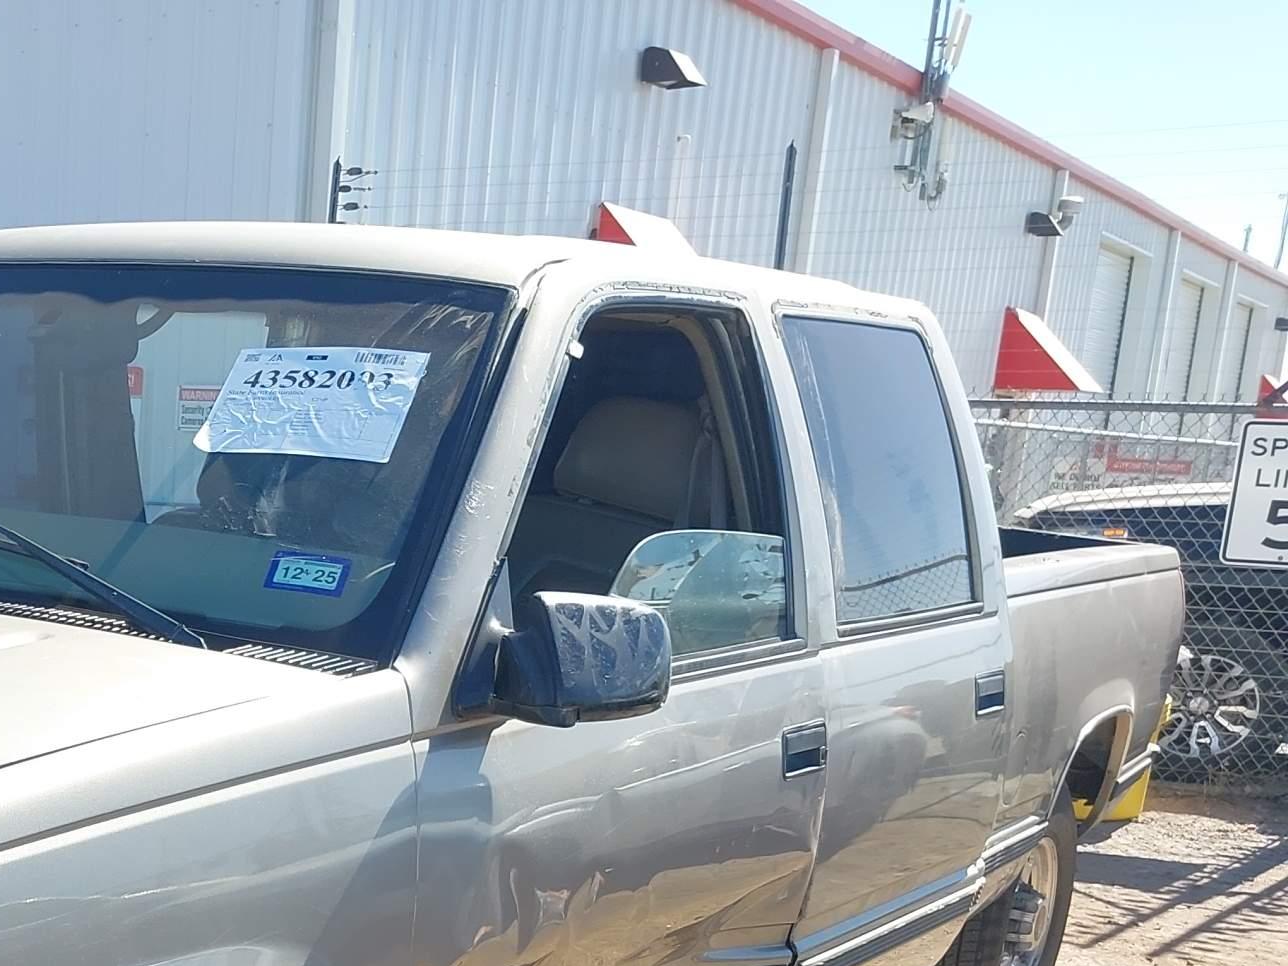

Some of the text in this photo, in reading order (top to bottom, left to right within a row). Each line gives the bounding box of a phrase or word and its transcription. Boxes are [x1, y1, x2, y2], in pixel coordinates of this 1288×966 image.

[182, 390, 217, 401] WARNIN
[1251, 437, 1288, 457] SP
[282, 565, 338, 585] 12 25
